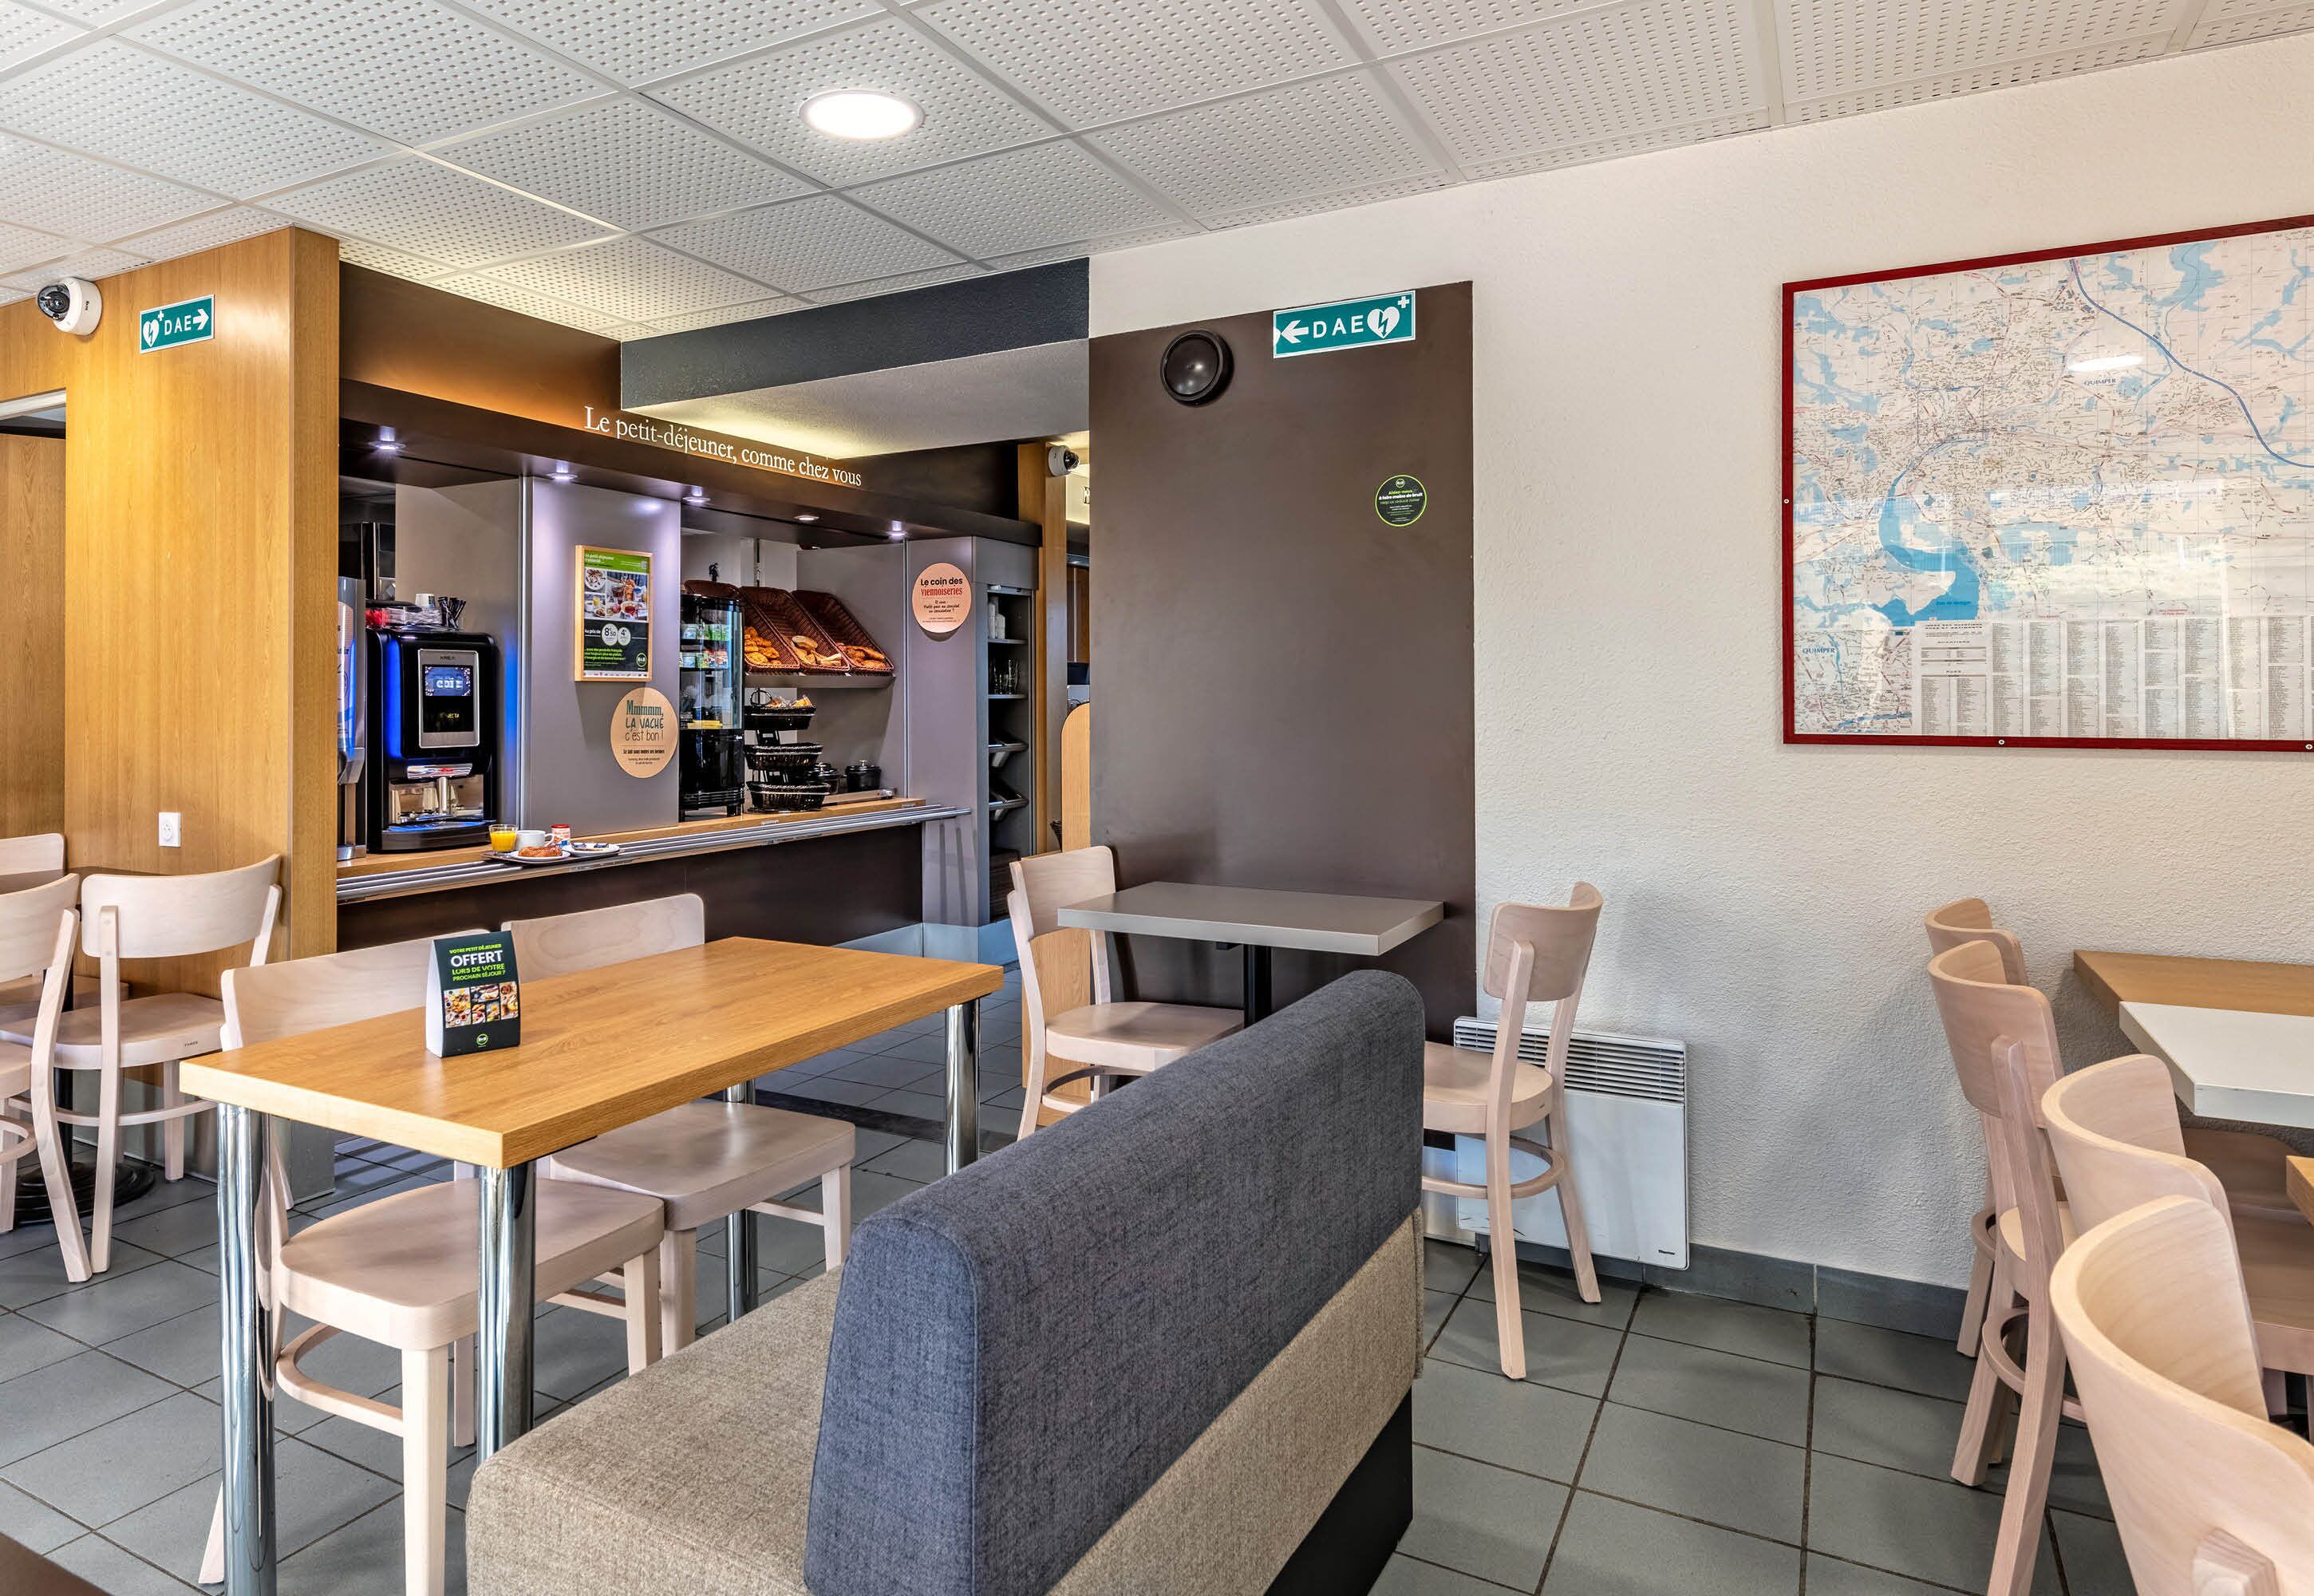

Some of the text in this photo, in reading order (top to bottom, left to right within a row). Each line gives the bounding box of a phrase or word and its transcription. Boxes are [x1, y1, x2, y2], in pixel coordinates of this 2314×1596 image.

[164, 315, 192, 336] DAE
[1313, 315, 1364, 339] DAE
[584, 406, 861, 486] Le petit-déjeuner, comme chez vous
[921, 585, 963, 596] viennoiseries
[626, 718, 664, 729] LA VACHE
[625, 729, 663, 741] c'est bon !
[451, 950, 503, 967] OFFERT
